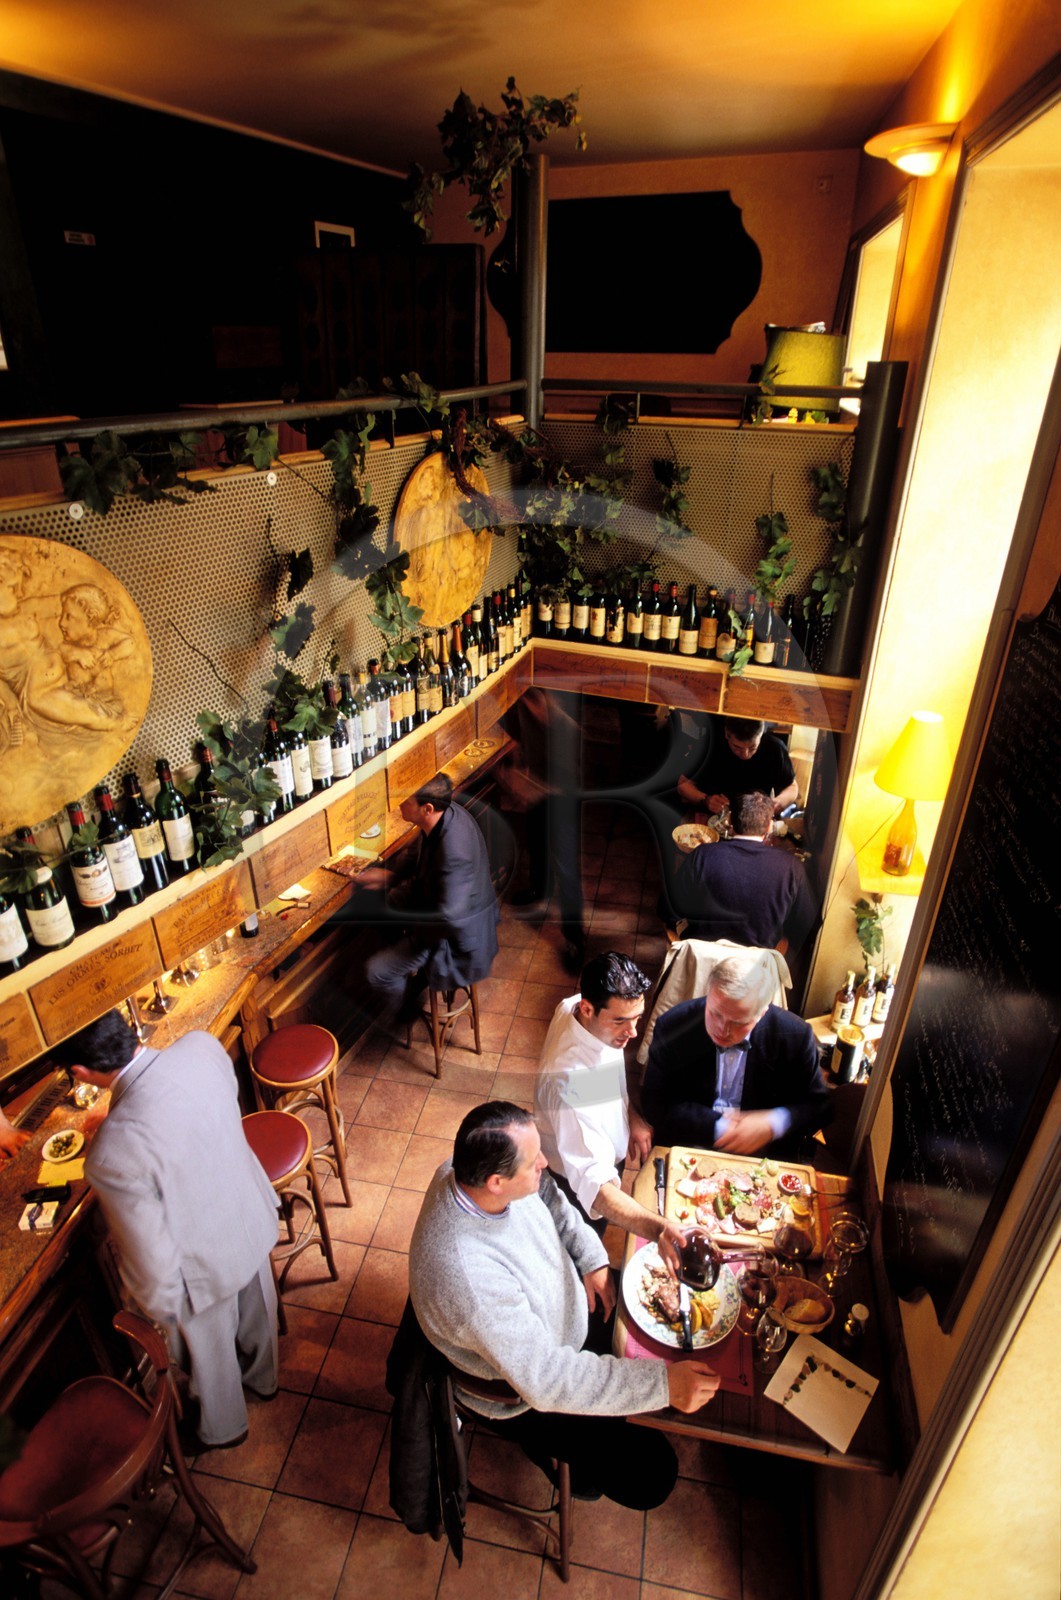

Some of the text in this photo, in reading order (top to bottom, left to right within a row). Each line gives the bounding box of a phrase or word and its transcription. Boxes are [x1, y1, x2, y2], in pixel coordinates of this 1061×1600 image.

[48, 943, 143, 1005] LES ORMES SORBET
[69, 946, 111, 975] CHATEAU
